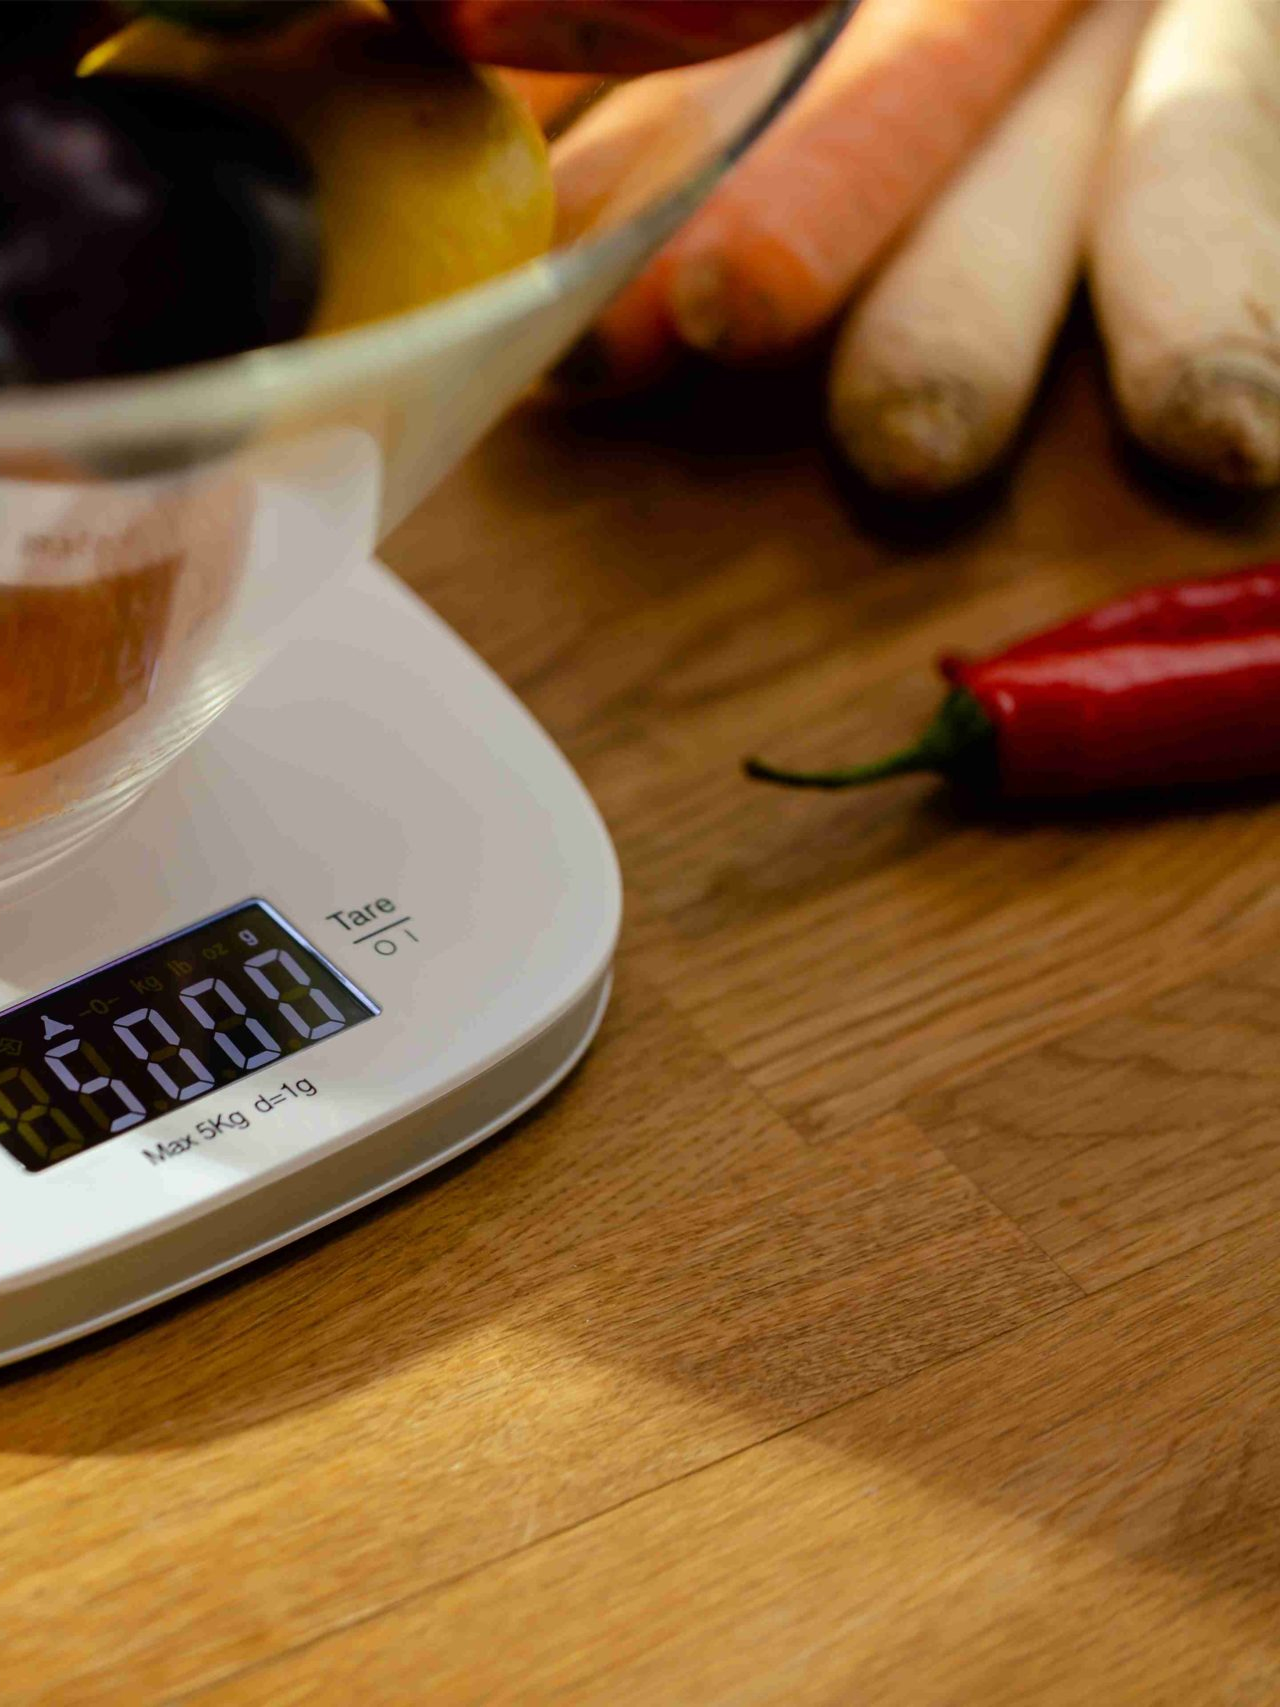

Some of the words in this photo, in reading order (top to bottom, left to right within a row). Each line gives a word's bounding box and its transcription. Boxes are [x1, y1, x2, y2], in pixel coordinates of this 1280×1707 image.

[325, 898, 396, 931] Tare
[129, 976, 164, 995] kg
[238, 929, 259, 946] g
[44, 949, 345, 1133] 5000
[141, 1134, 199, 1165] Max
[195, 1111, 250, 1140] 5Kg
[254, 1078, 317, 1113] d=1g
